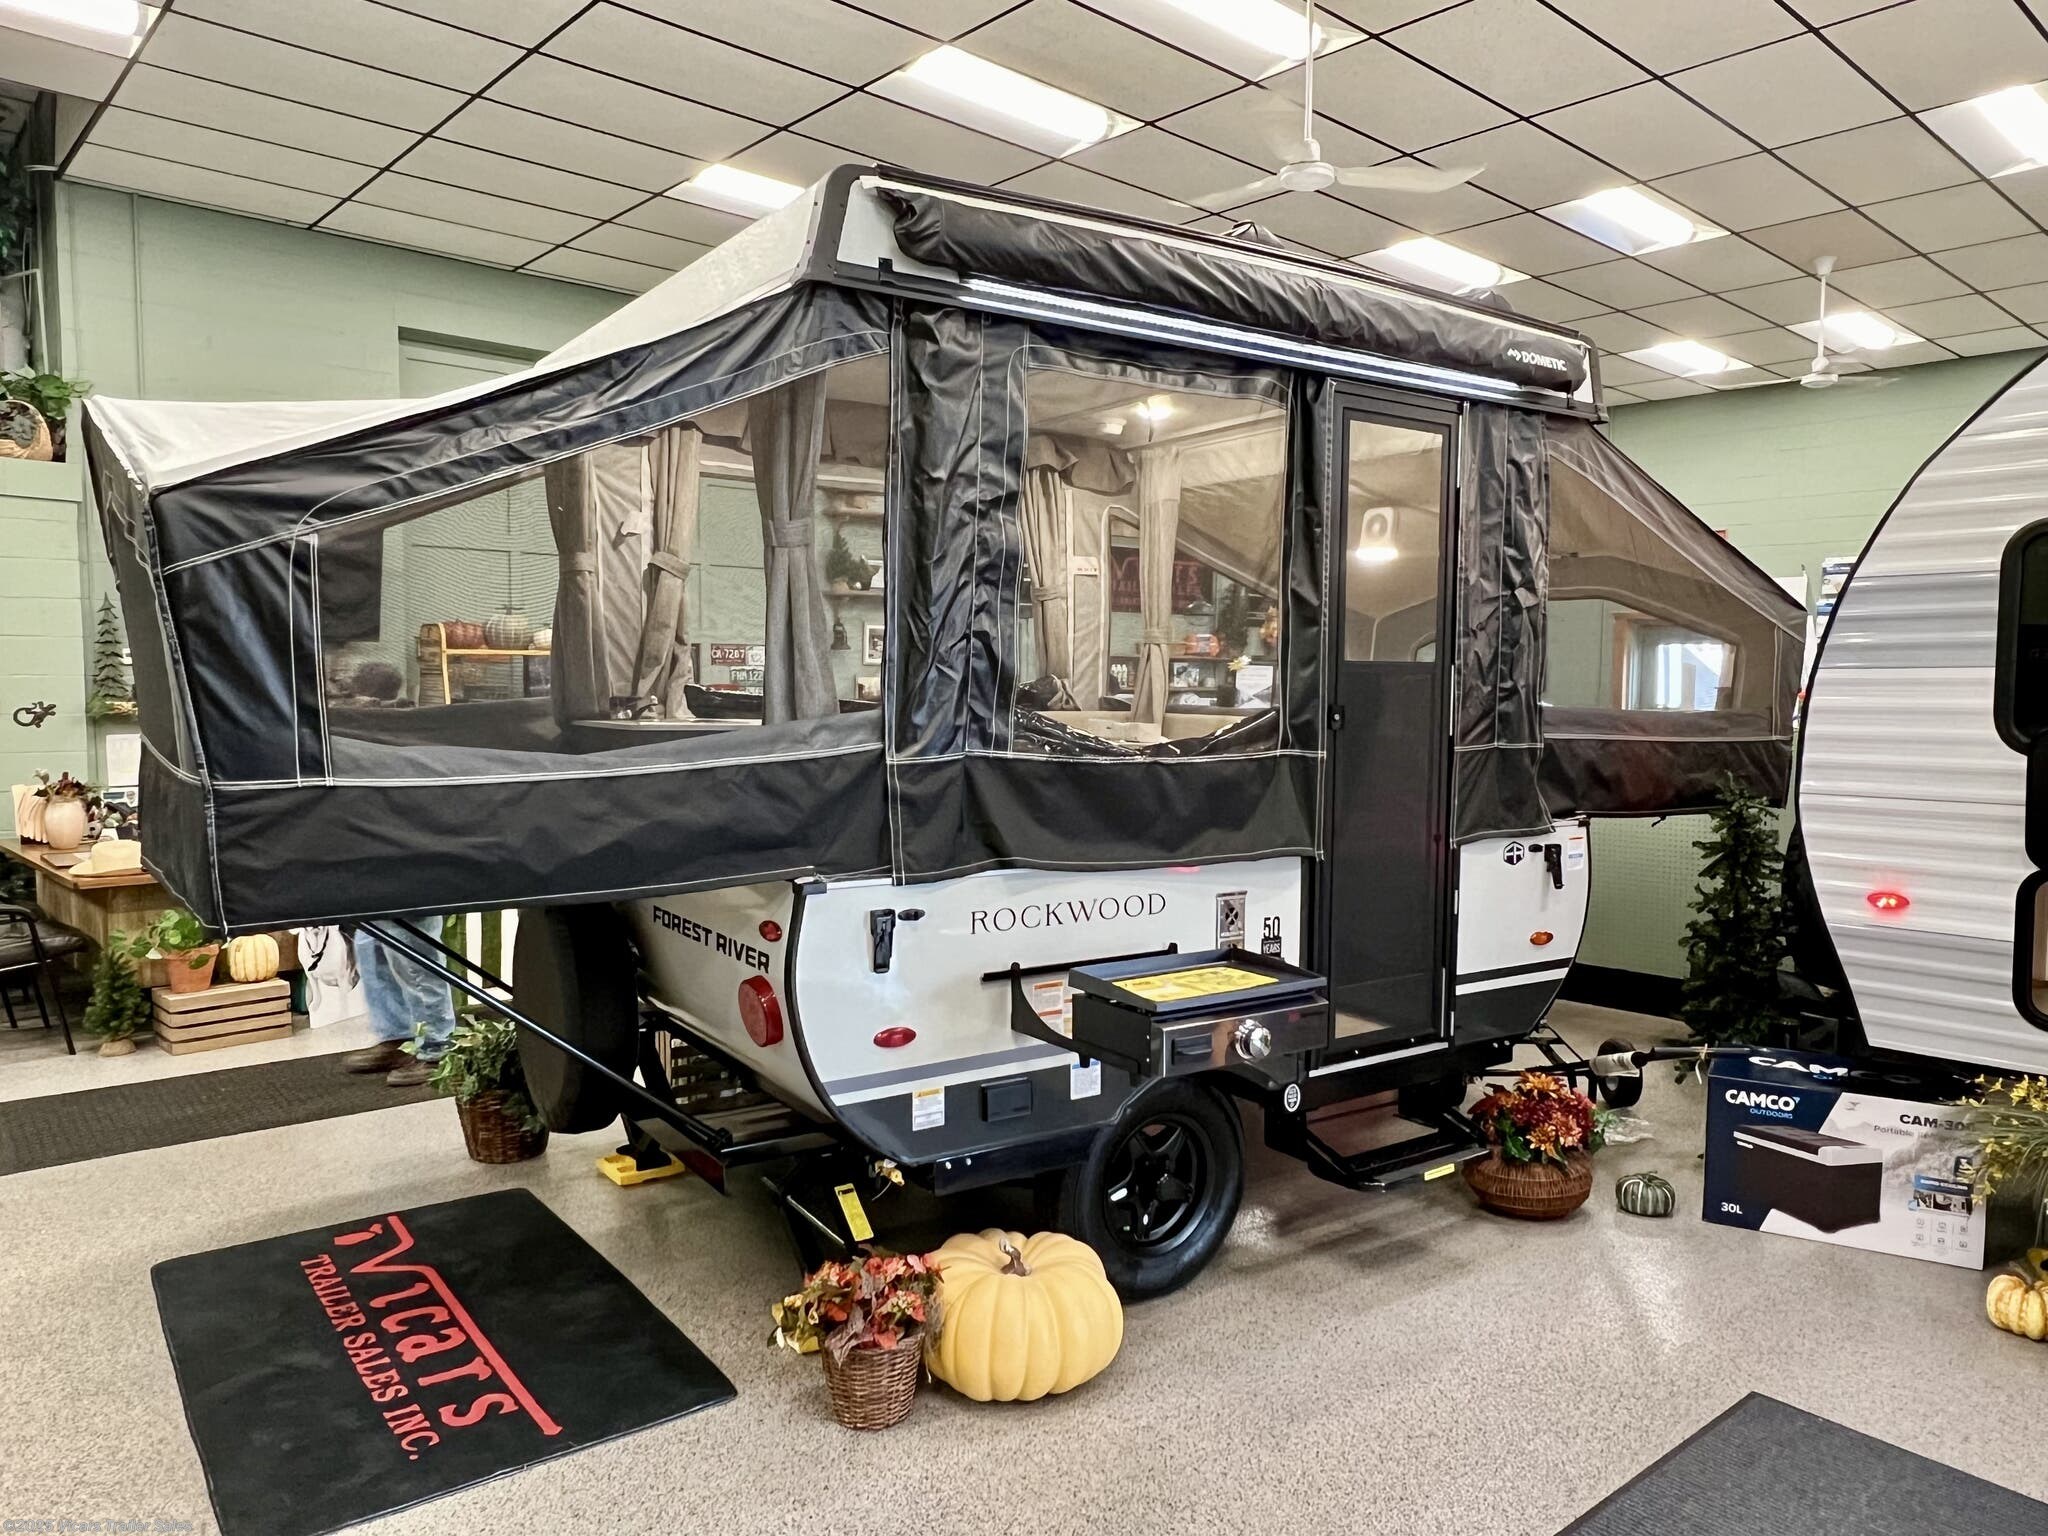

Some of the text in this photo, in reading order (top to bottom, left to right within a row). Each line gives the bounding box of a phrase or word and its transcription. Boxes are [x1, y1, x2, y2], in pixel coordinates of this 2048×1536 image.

[1521, 351, 1567, 371] DOMETIC
[970, 893, 1166, 935] ROCKWOOD
[1263, 916, 1281, 939] 50
[653, 905, 770, 974] FOREST RIVER
[1725, 1089, 1797, 1112] CAMCO
[1750, 1107, 1793, 1119] OUTDOORS
[1721, 1202, 1743, 1215] 30L
[334, 1215, 563, 1436] Vicars
[301, 1254, 440, 1461] TRAILER SALES INC.
